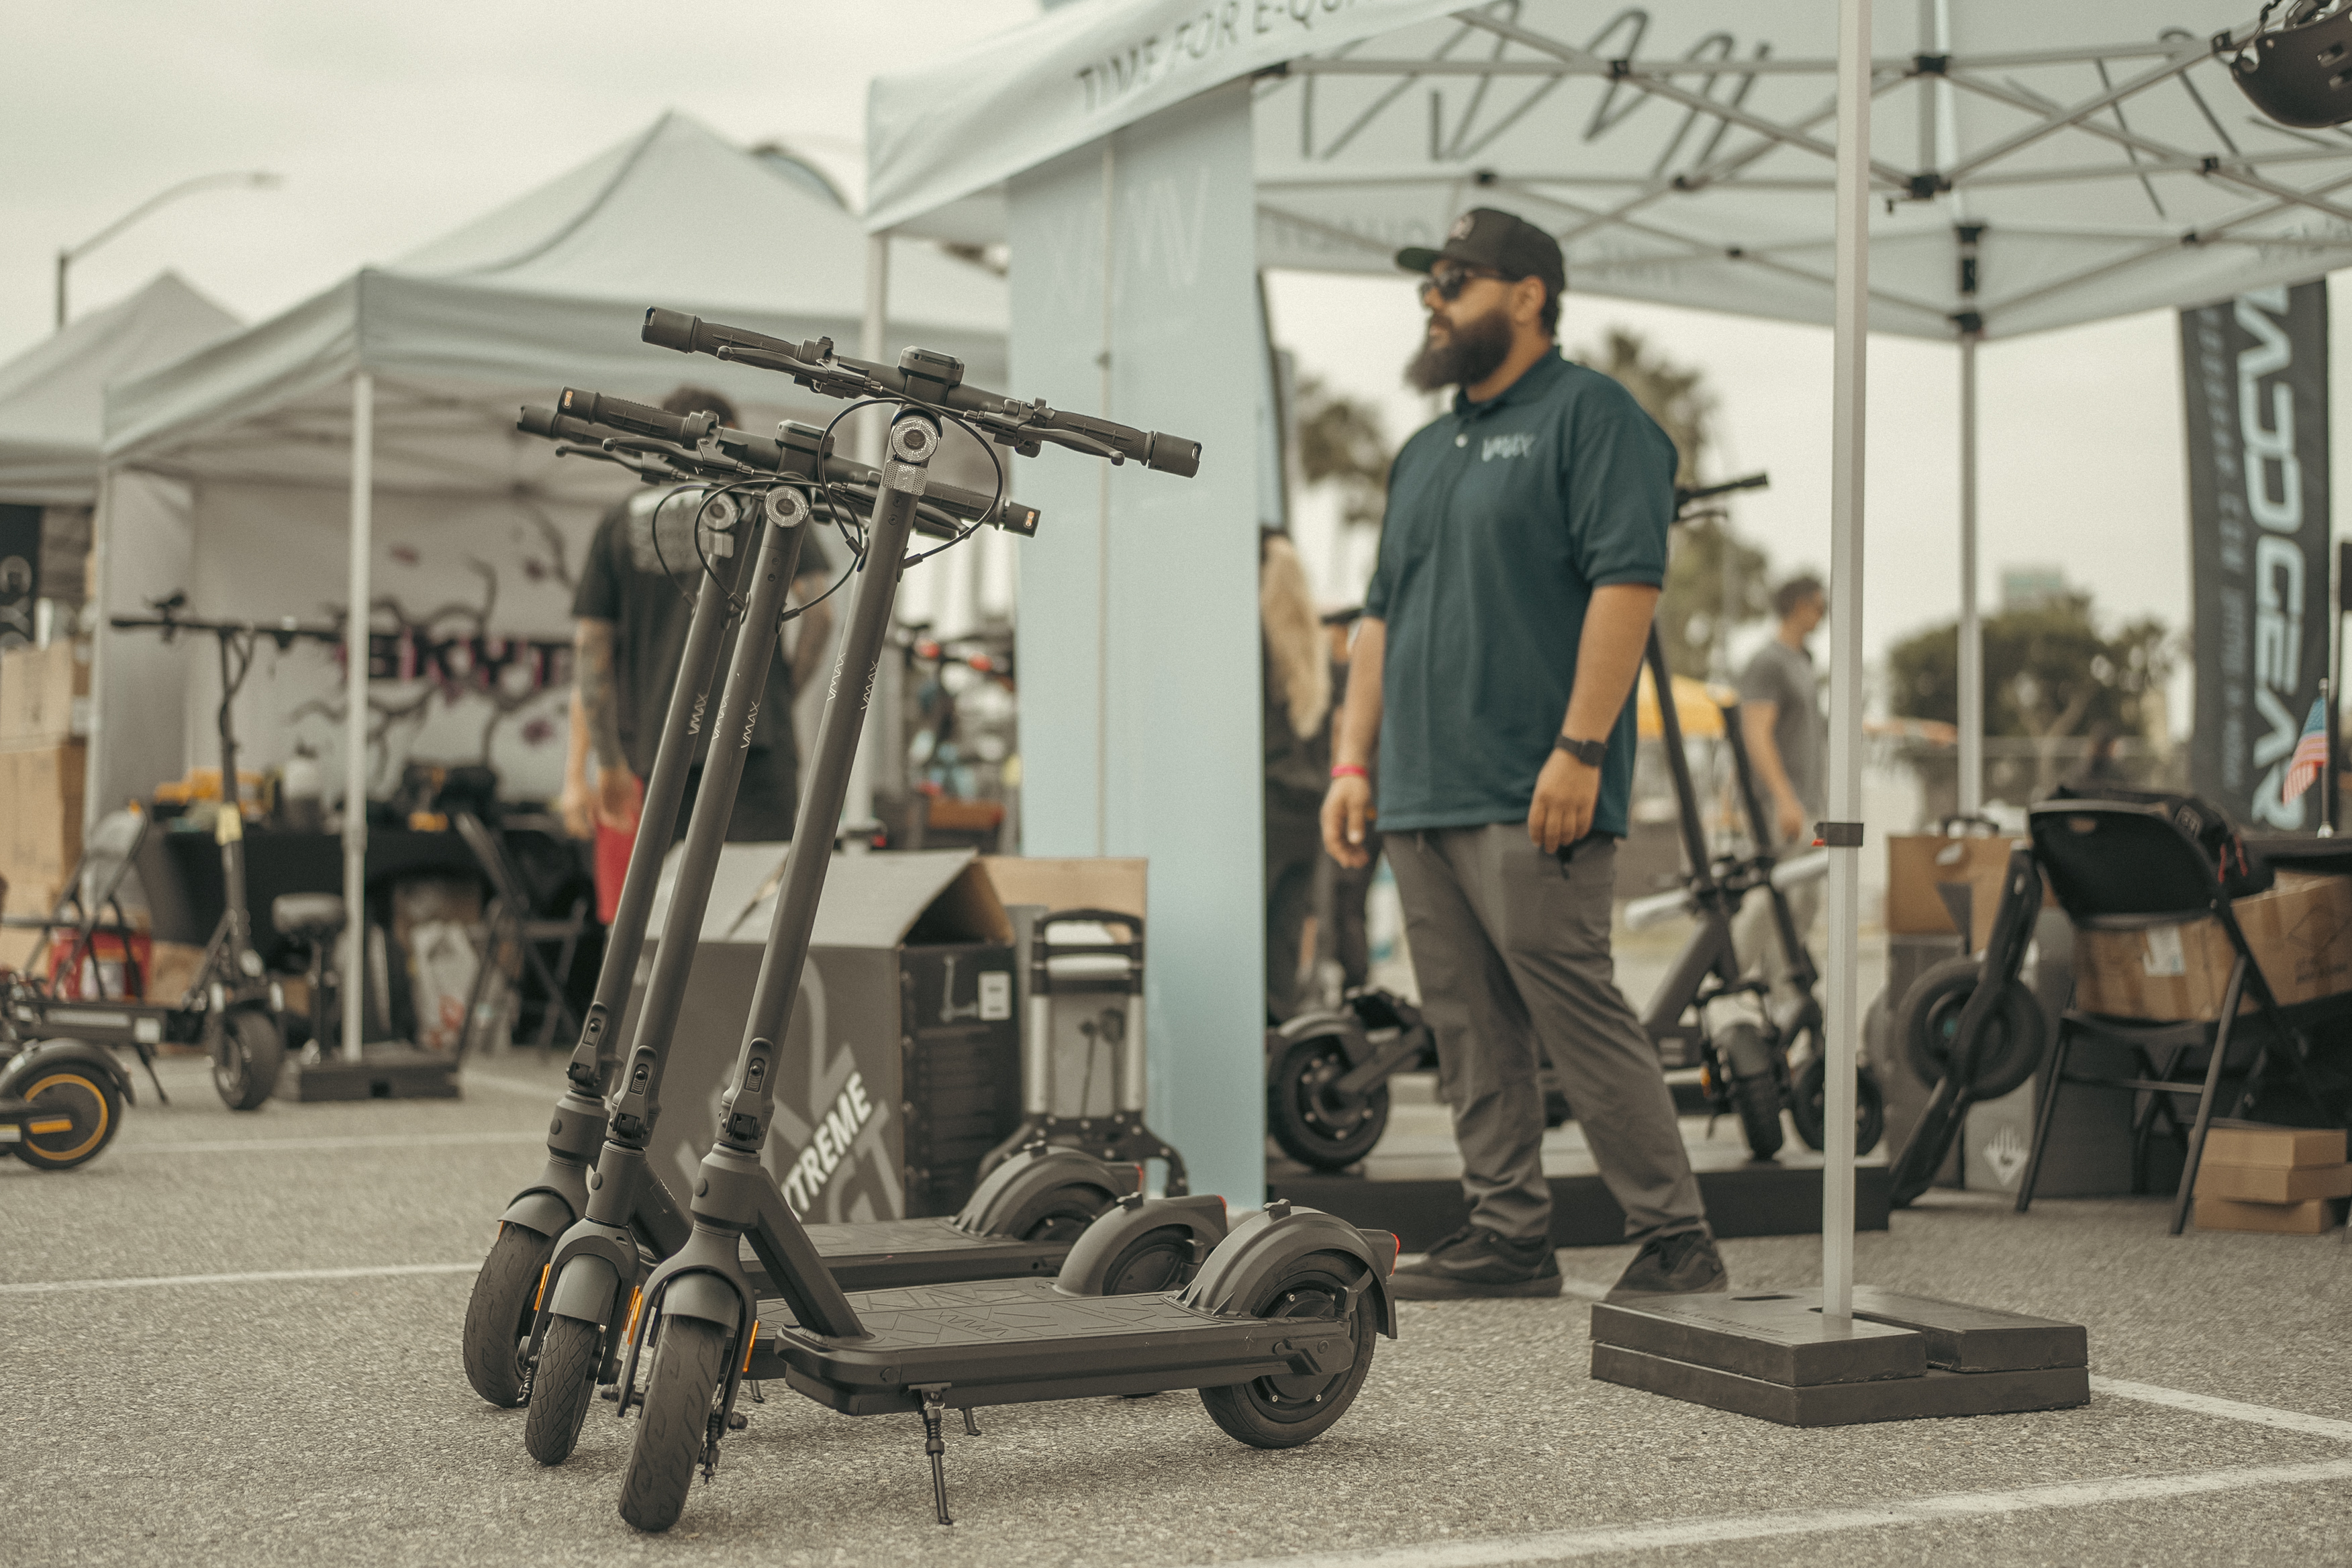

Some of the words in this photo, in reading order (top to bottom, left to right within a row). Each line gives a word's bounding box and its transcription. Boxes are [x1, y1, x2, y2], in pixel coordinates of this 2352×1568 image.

[826, 652, 846, 702] VMAX
[861, 660, 879, 709] VMAX
[687, 693, 708, 735] VMAX
[740, 701, 761, 748] VMAX
